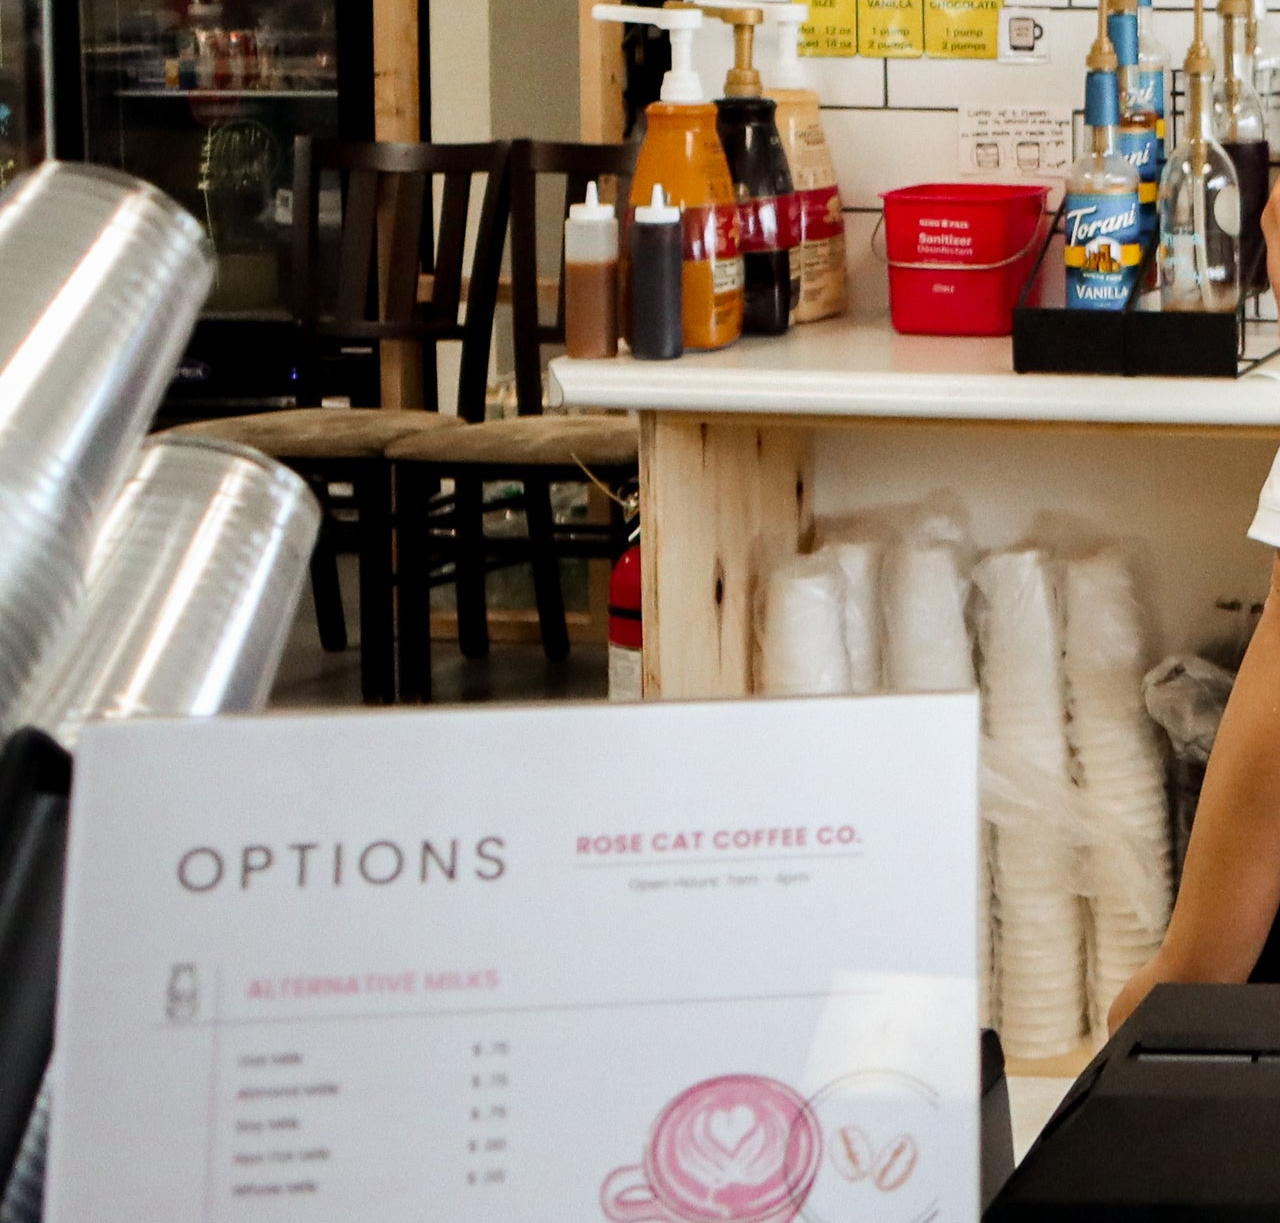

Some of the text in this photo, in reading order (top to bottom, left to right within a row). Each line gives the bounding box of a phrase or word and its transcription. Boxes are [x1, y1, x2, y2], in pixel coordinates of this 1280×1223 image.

[811, 0, 836, 9] SIZE
[867, 0, 914, 10] VANILLA
[929, 0, 998, 11] CHOCOLATE
[825, 26, 838, 35] 12
[953, 29, 984, 40] pump
[950, 42, 987, 53] pumps
[1067, 204, 1136, 248] Torani
[919, 232, 972, 247] Sanitizer
[1076, 284, 1130, 300] VANILLA
[575, 824, 863, 855] ROSE CAT COFFEE CO.
[177, 837, 507, 894] OPTIONS
[246, 969, 500, 1000] ALTERNATIVE MILKS
